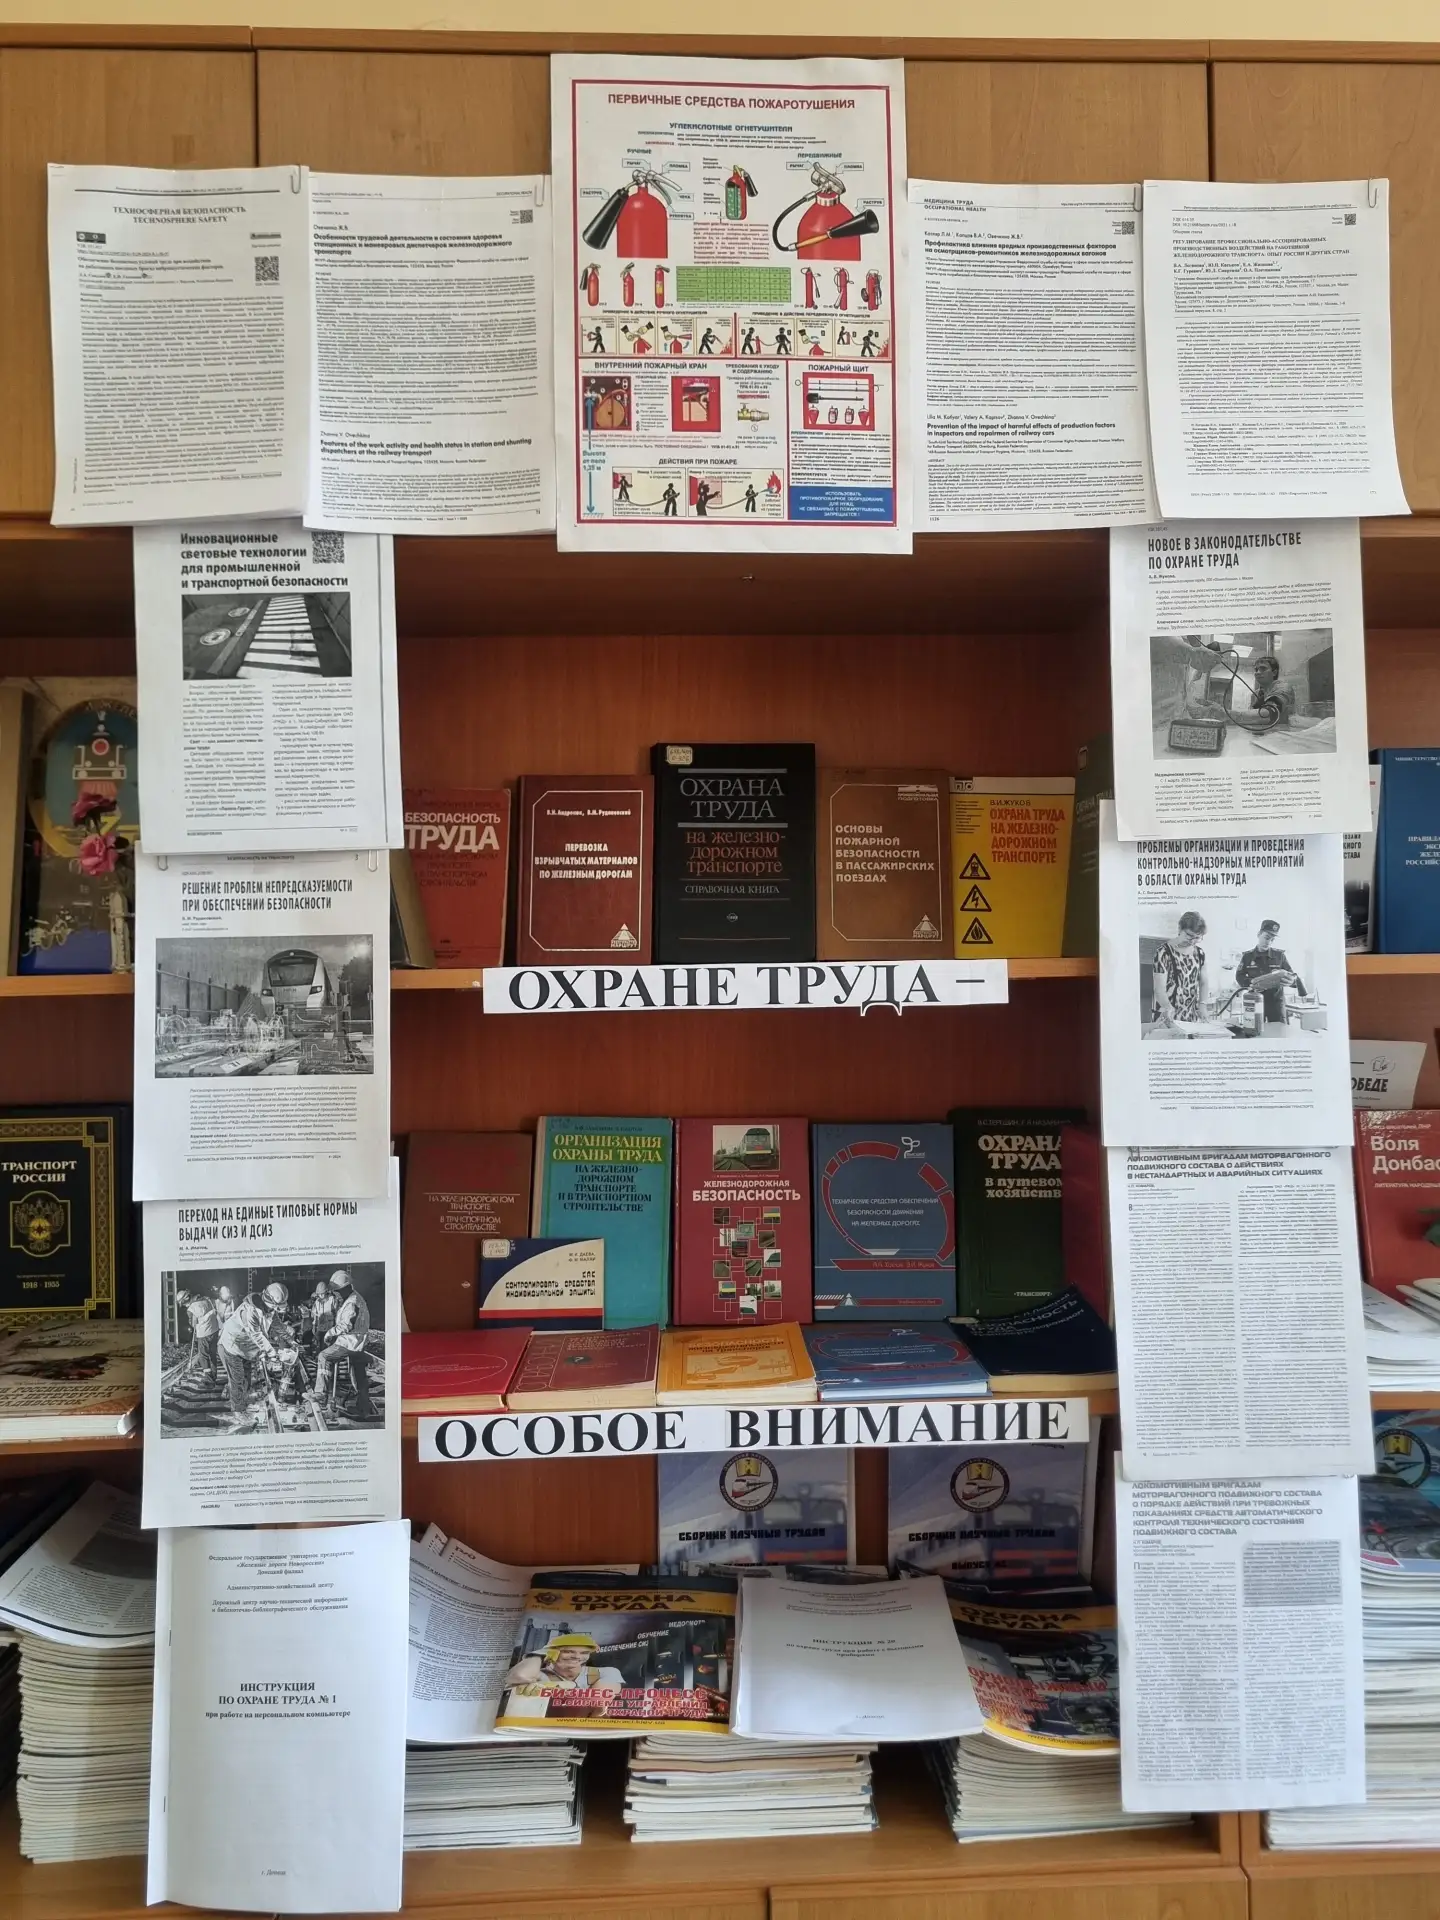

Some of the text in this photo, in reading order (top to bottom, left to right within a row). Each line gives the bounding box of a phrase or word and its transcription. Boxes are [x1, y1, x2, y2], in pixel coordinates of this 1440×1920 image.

[608, 94, 855, 109] ПЕРВИЧНЫЕ СРЕДСТВА ПОЖАРОТУШЕНИЯ
[670, 123, 732, 131] УГЛЕКИСЛОТНЫЕ
[114, 206, 246, 216] ТЕХНОСФЕРНАЯ БЕЗОПАСНОСТЬ
[925, 240, 970, 249] Профилактика
[1027, 243, 1084, 251] производственных
[1086, 243, 1116, 251] факторов
[378, 449, 401, 457] railway
[403, 449, 432, 457] transport
[180, 533, 278, 545] Инновационные
[1148, 532, 1302, 552] НОВОЕ В ЗАКОНОДАТЕЛЬСТВЕ
[181, 547, 307, 559] световые технологии
[1148, 552, 1239, 570] ПО ОХРАНЕ ТРУДА
[181, 560, 301, 575] для промышленной
[182, 575, 348, 591] и транспортной безопасности
[680, 778, 784, 796] ОХРАНА
[691, 800, 776, 821] ТРУДА
[990, 808, 1065, 821] ОХРАНА ТРУДА
[405, 812, 501, 823] БЕЗОПАСНОСТЬ
[835, 825, 883, 834] ОСНОВЫ
[990, 822, 1005, 834] НА
[1007, 822, 1059, 835] ЖЕЛЕЗНО-
[404, 825, 500, 853] ТРУДА
[686, 831, 786, 844] на железно-
[835, 836, 900, 846] ПОЖАРНОЙ
[991, 837, 1057, 850] ДОРОЖНОМ
[565, 843, 608, 852] ПЕРЕВОЗКА
[1137, 838, 1305, 854] ПРОБЛЕМЫ ОРГАНИЗАЦИИ И ПРОВЕДЕНИЯ
[690, 846, 778, 861] дорожном
[835, 850, 920, 858] БЕЗОПАСНОСТИ
[992, 851, 1056, 864] ТРАНСПОРТЕ
[534, 856, 638, 865] ВЗРЫВЧАТЫХ МАТЕРИАЛОВ
[835, 861, 935, 871] В ПАССАЖИРСКИХ
[1137, 853, 1305, 870] КОНТРОЛЬНО-НАДЗОРНЫХ МЕРОПРИЯТИЙ
[686, 860, 783, 876] транспорте
[539, 870, 633, 880] ПО ЖЕЛЕЗНЫМ ДОРОГАМ
[835, 873, 887, 883] ПОЕЗДАХ
[1138, 872, 1247, 887] В ОБЛАСТИ ОХРАНЫ ТРУДА
[182, 879, 353, 895] РЕШЕНИЕ ПРОБЛЕМ НЕПРЕДСКАЗУЕМОСТИ
[685, 885, 779, 894] СПРАВОЧНАЯ КНИГА
[182, 896, 332, 912] ПРИ ОБЕСПЕЧЕНИИ БЕЗОПАСНОСТИ
[508, 966, 739, 1011] ОХРАНЕ
[757, 965, 941, 1017] ТРУДА
[1351, 1077, 1389, 1092] ОБЕДЕ
[554, 1134, 662, 1149] ОРГАНИЗАЦИЯ
[1371, 1136, 1419, 1151] Воля
[552, 1149, 663, 1163] ОХРАНЫ ТРУДА
[988, 1152, 1062, 1171] ТРУДА
[1127, 1151, 1331, 1162] ЛОКОМОТИВНЫМ БРИГАДАМ МОТОРВАГОННОГО
[1, 1160, 77, 1171] ТРАНСПОРТ
[1127, 1163, 1186, 1171] ПОДВИЖНОГО
[1188, 1162, 1224, 1170] СОСТАВА
[1234, 1160, 1284, 1169] ДЕЙСТВИЯХ
[12, 1173, 66, 1183] РОССИИ
[704, 1180, 790, 1188] ЖЕЛЕЗНОДОРОЖНАЯ
[692, 1190, 801, 1202] БЕЗОПАСНОСТЬ
[178, 1202, 358, 1224] ПЕРЕХОД НА ЕДИНЫЕ ТИПОВЫЕ НОРМЫ
[179, 1224, 273, 1241] ВЫДАЧИ СИЗ И ДСИЗ
[22, 1281, 38, 1289] 1918
[505, 1280, 596, 1289] КОНТРОЛИРОВАТЬ СРЕДСТВА
[506, 1288, 596, 1298] ИНДИВИДУАЛЬНОЙ ЗАЩИТЫ
[434, 1400, 1070, 1460] ОСОБОЕ ВНИМАНИЕ
[1235, 1508, 1323, 1516] АВТОМАТИЧЕСКОГО
[227, 1583, 316, 1591] Административно-хозяйственный
[571, 1603, 671, 1611] ТРУДА
[958, 1606, 1083, 1623] ОХРАНА
[963, 1614, 1063, 1630] ТРУДА
[637, 1630, 669, 1639] ОБУЧЕНИЕ
[240, 1682, 316, 1693] ИНСТРУКЦИЯ
[218, 1695, 336, 1705] ПО ОХРАНЕ ТРУДА № 1
[540, 1688, 708, 1700] БИЗНЕС-ПРОЦЕСС
